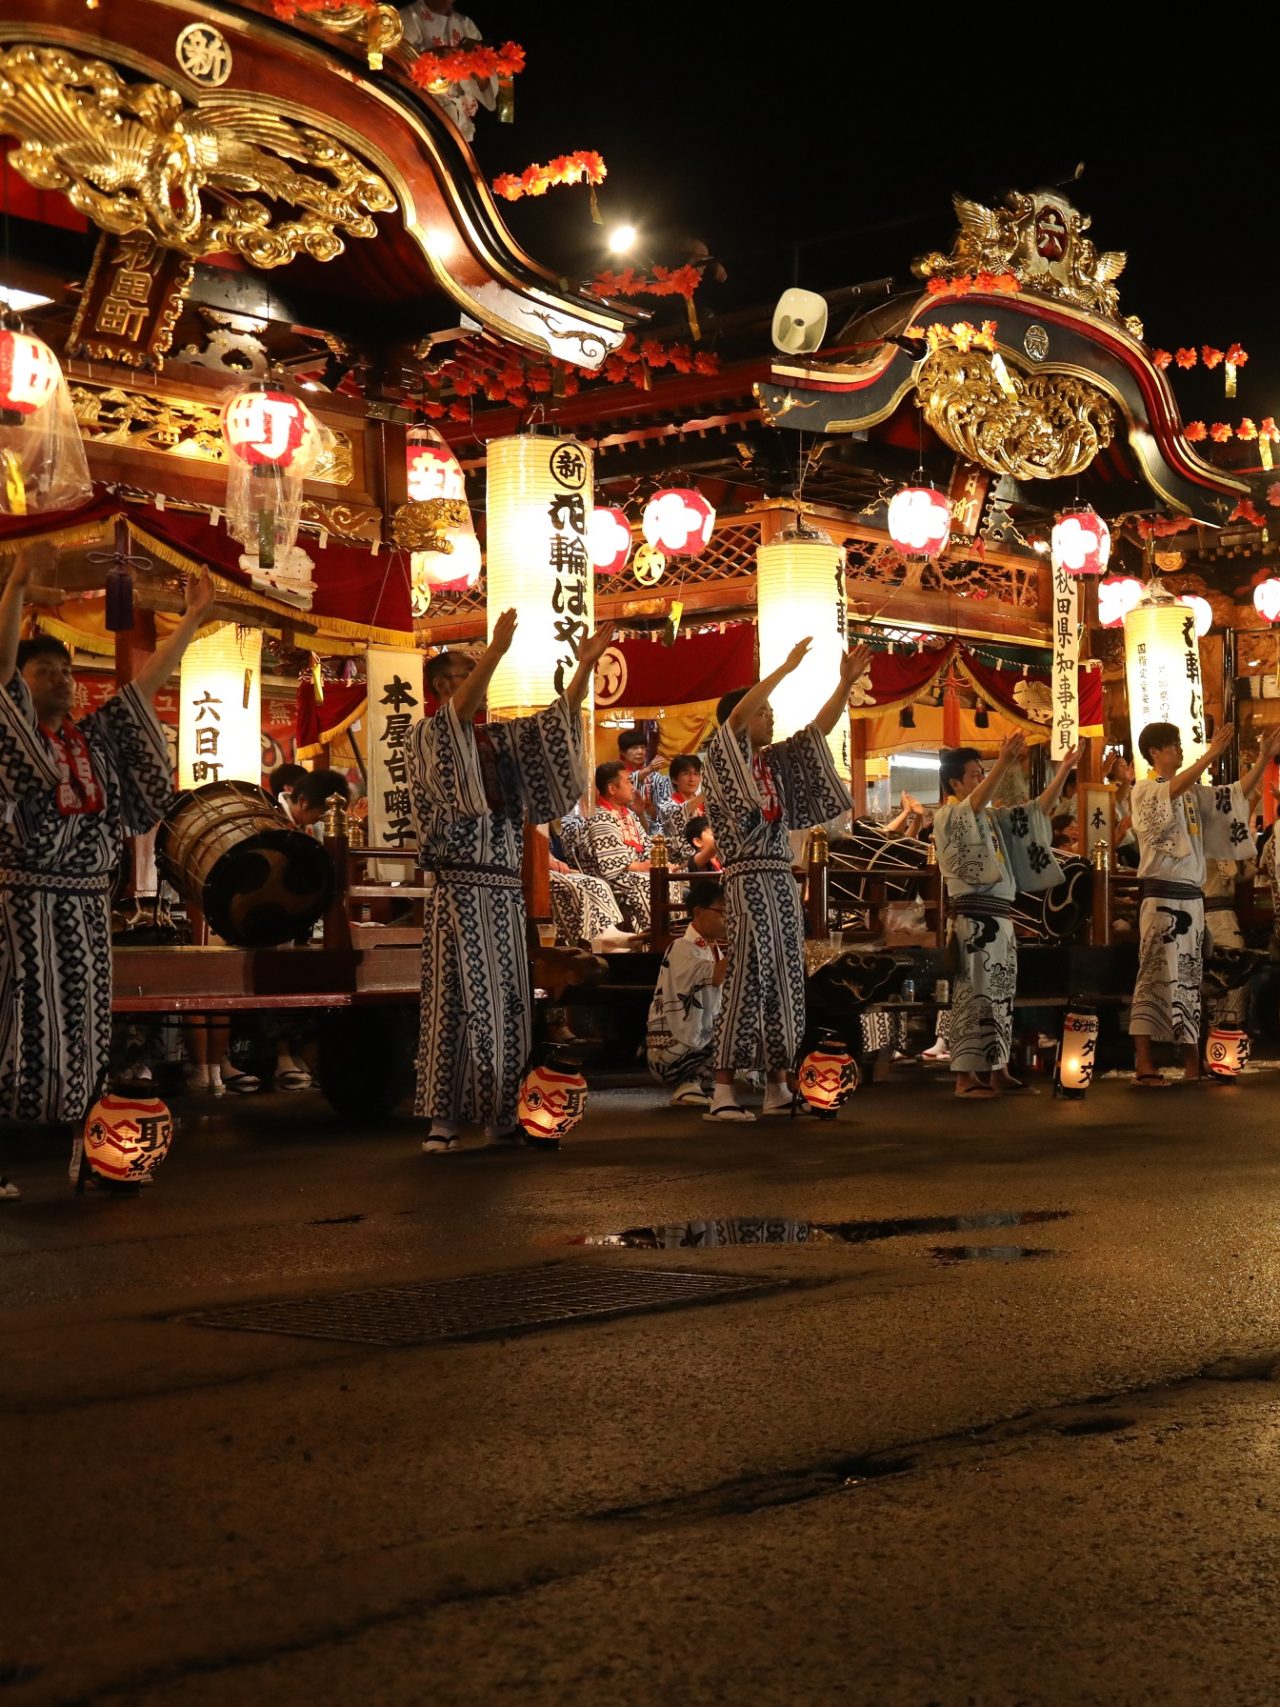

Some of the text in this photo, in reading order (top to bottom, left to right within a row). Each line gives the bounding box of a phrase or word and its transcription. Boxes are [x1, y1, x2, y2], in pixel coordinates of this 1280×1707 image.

[179, 26, 229, 84] 新
[1038, 213, 1066, 252] 六
[227, 392, 299, 460] 町
[554, 447, 585, 486] 新
[953, 470, 980, 529] 日町
[1055, 568, 1076, 750] 秋田県知事賞
[193, 690, 224, 782] 六日町
[1212, 1044, 1225, 1060] 谷
